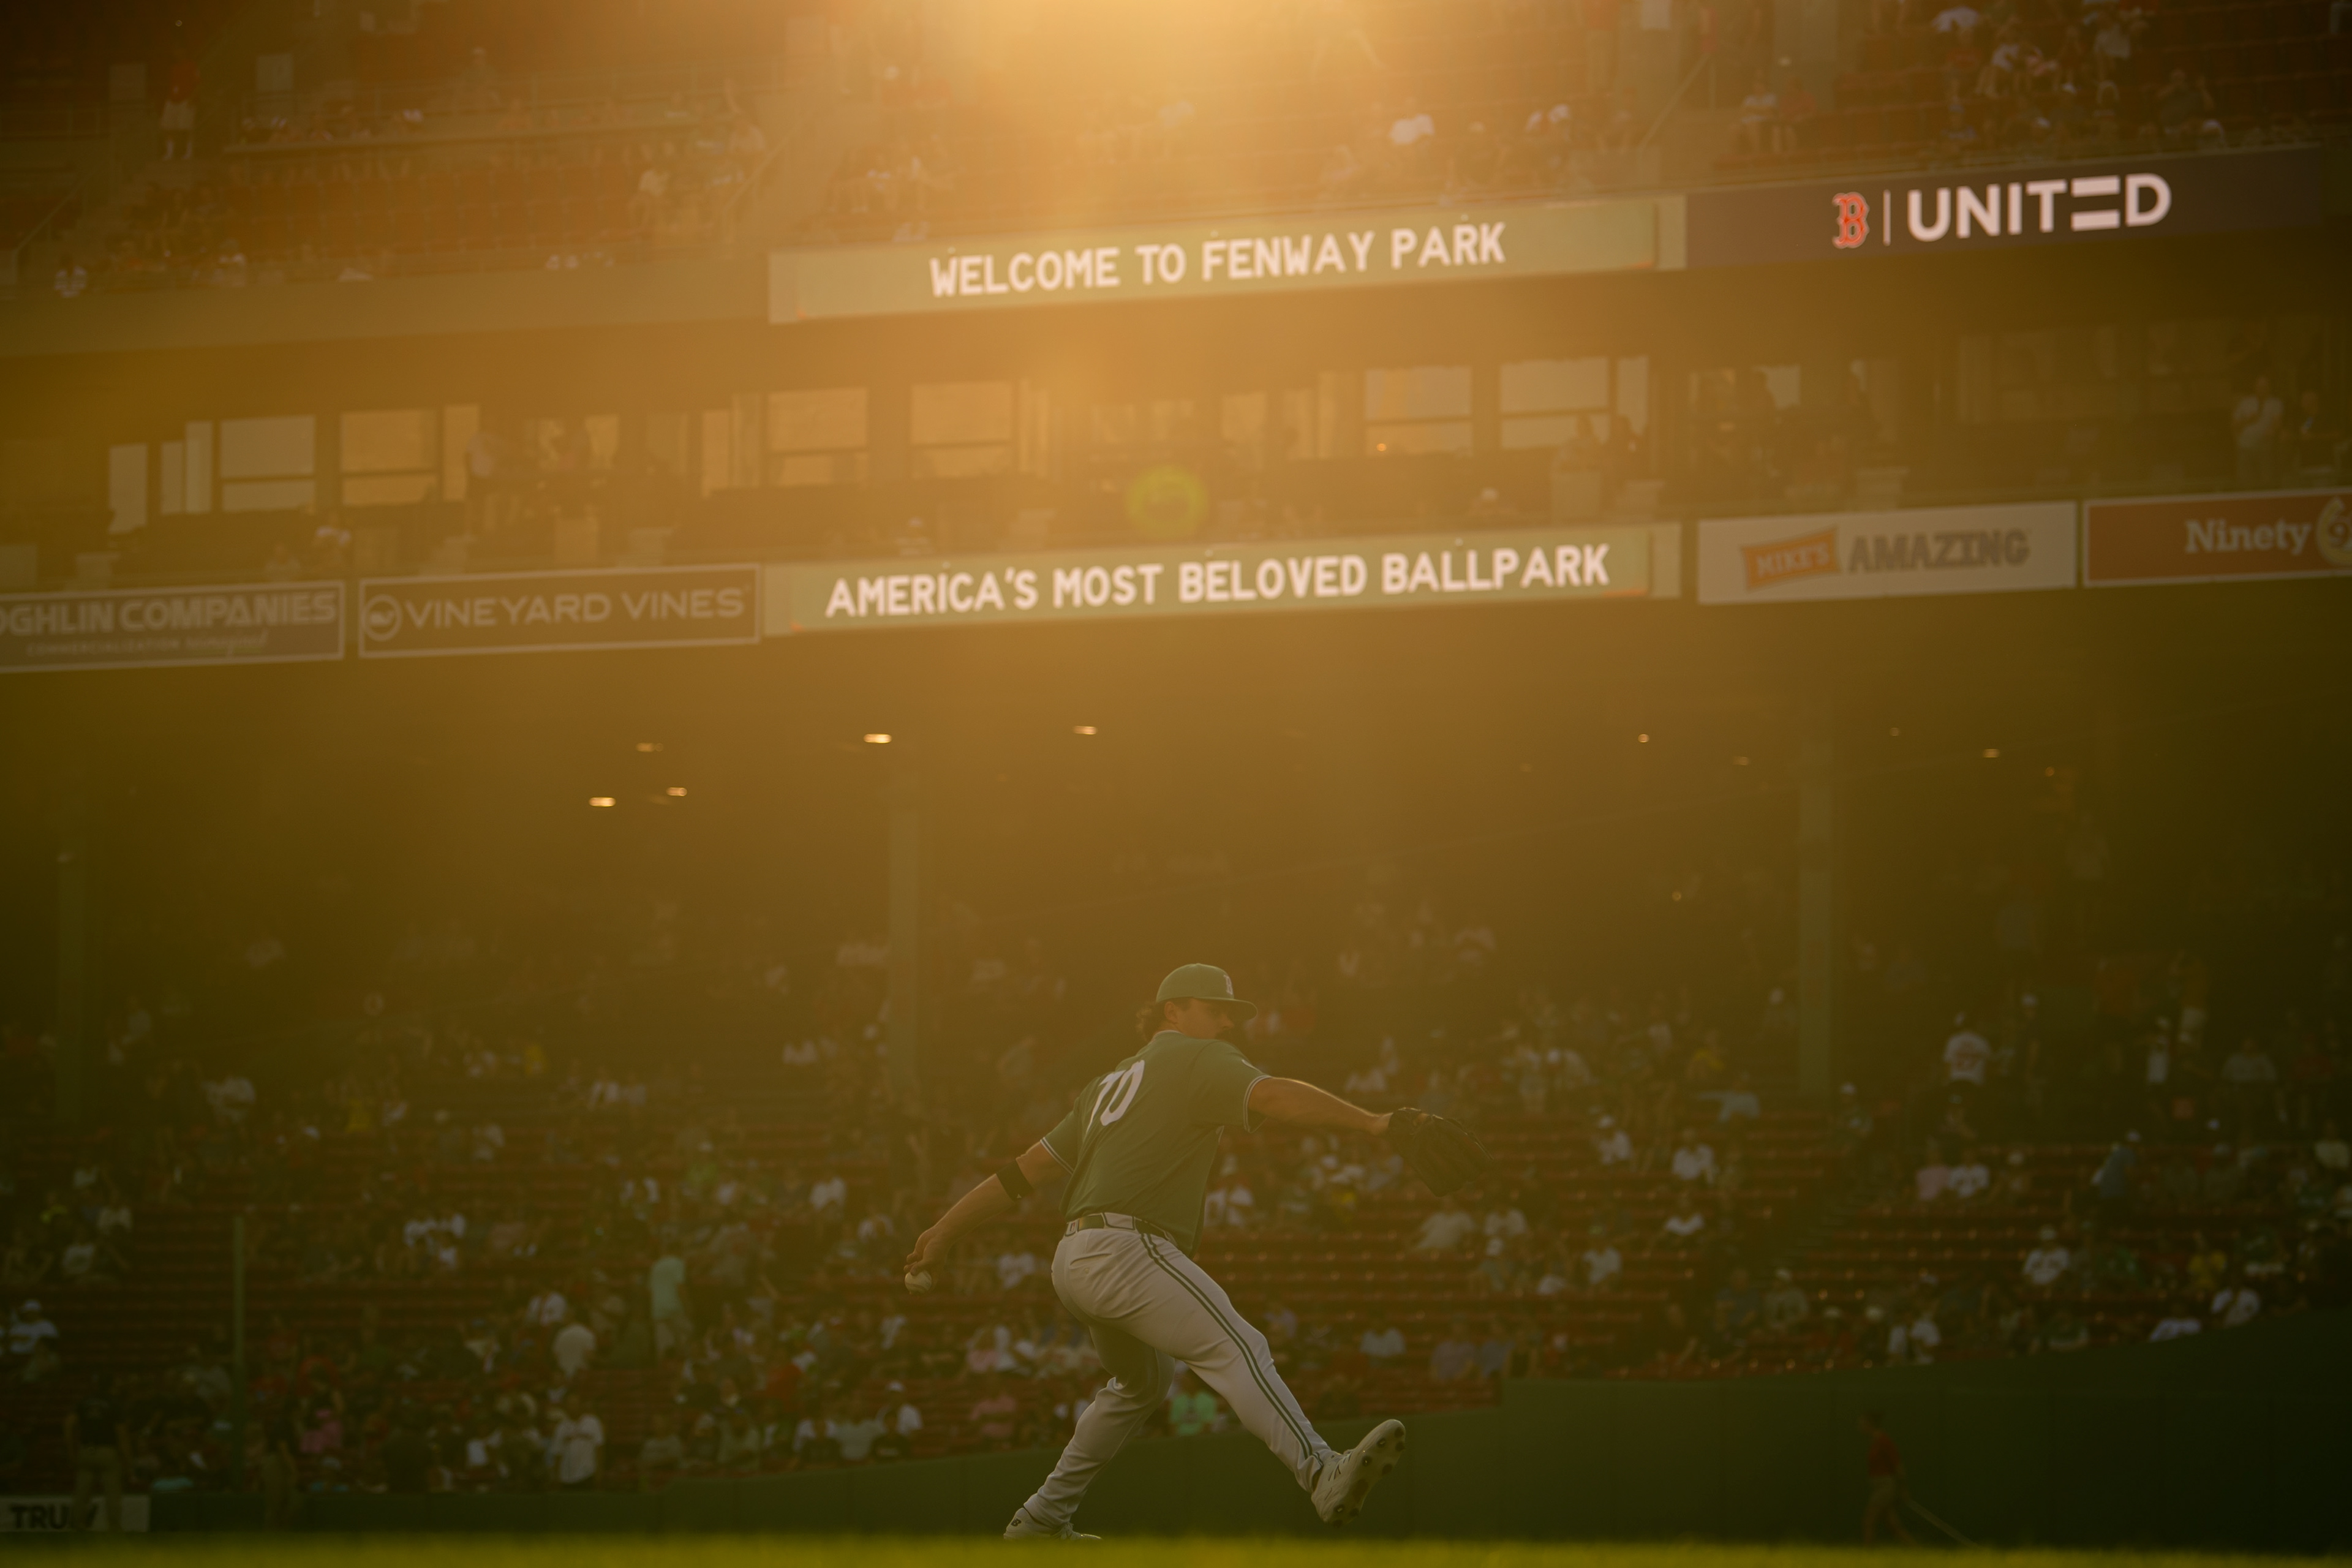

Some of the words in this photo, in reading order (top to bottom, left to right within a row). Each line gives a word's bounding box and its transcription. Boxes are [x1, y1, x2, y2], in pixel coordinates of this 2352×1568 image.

[1832, 191, 1871, 249] B
[1907, 172, 2173, 243] UNITED
[930, 244, 1120, 296] WELCOME
[1136, 239, 1186, 284] TO
[1203, 231, 1374, 280] FENWAY
[1392, 224, 1504, 268] PARK
[1755, 541, 1830, 578] MIKE'S
[1848, 526, 2031, 575] AMAZING
[2184, 518, 2312, 556] Ninety
[404, 592, 612, 629] VINEYARD
[620, 587, 745, 620] VINES
[827, 568, 1038, 616] AMERICA'S
[1054, 564, 1163, 607] MOST
[1180, 555, 1367, 602] BELOVED
[1383, 545, 1608, 593] BALLPARK
[0, 601, 115, 636] GHLIN
[119, 590, 336, 633] COMPANIES
[1083, 1059, 1145, 1138] 70
